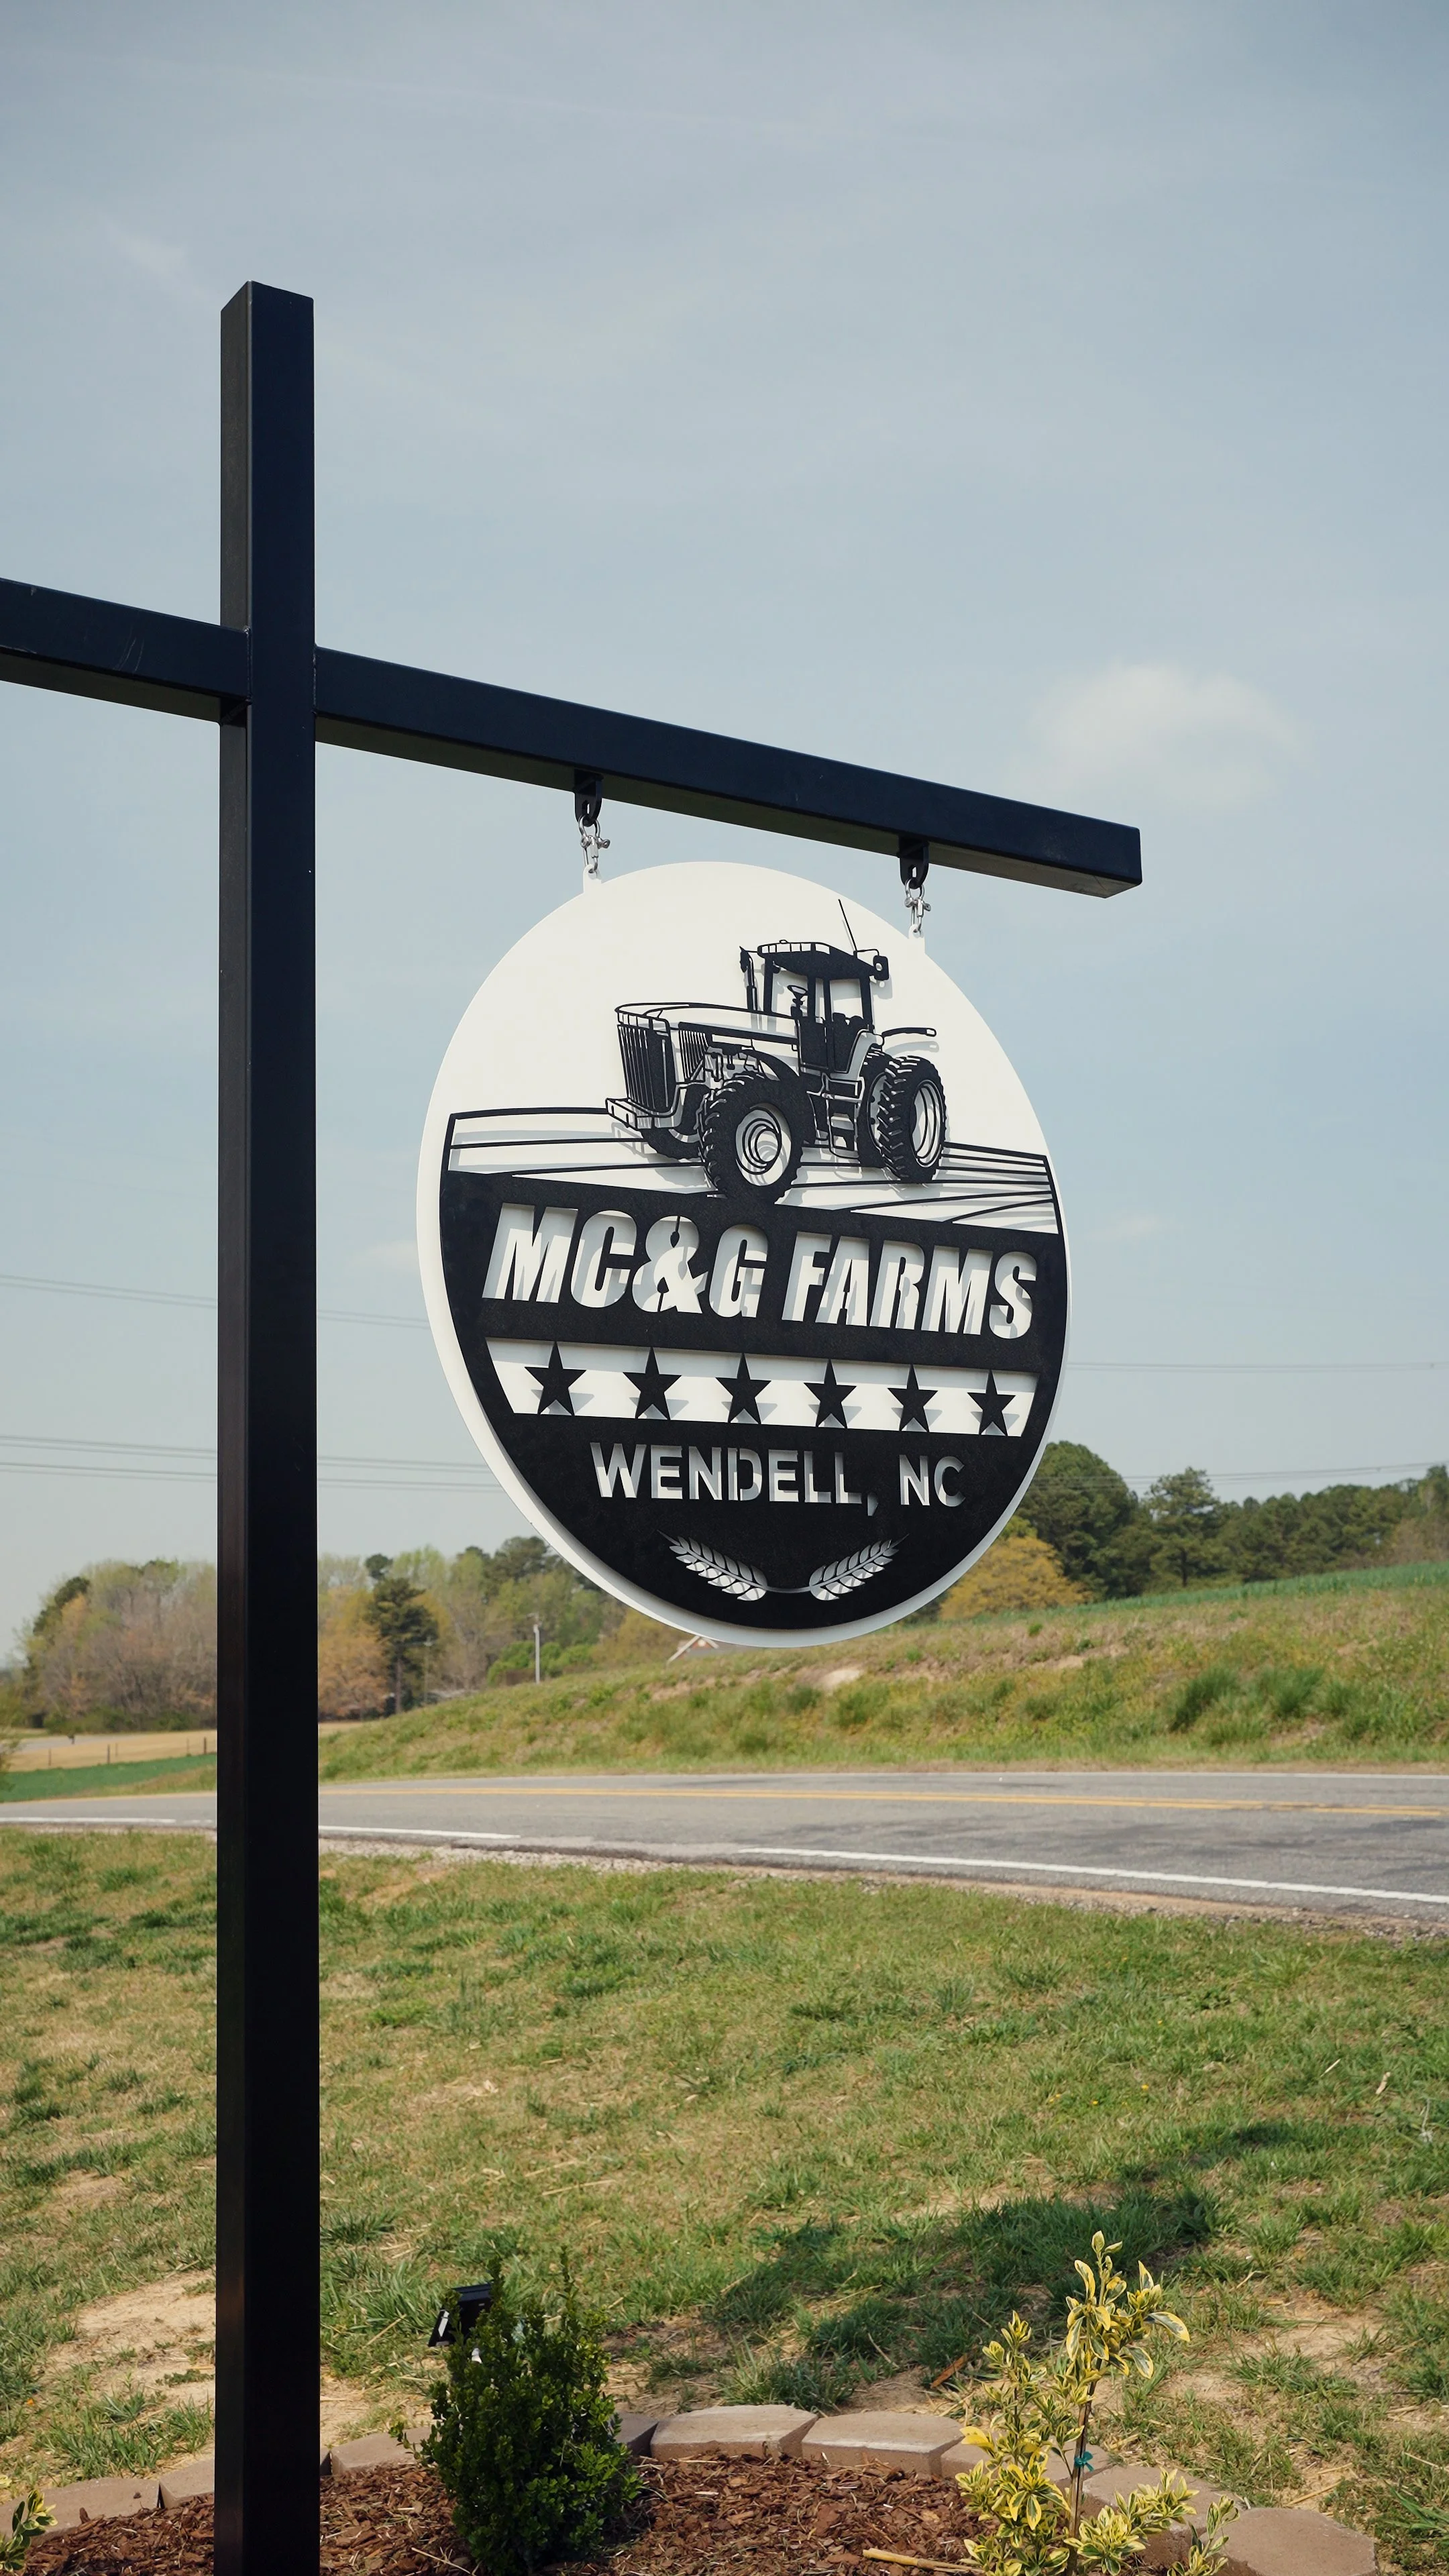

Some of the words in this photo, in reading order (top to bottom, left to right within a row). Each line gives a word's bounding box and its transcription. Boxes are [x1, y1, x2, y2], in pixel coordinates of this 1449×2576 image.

[482, 1203, 769, 1319] MC&G
[782, 1231, 1038, 1339] FARMS
[591, 1442, 879, 1516] WENDELL,
[900, 1455, 967, 1507] NC
